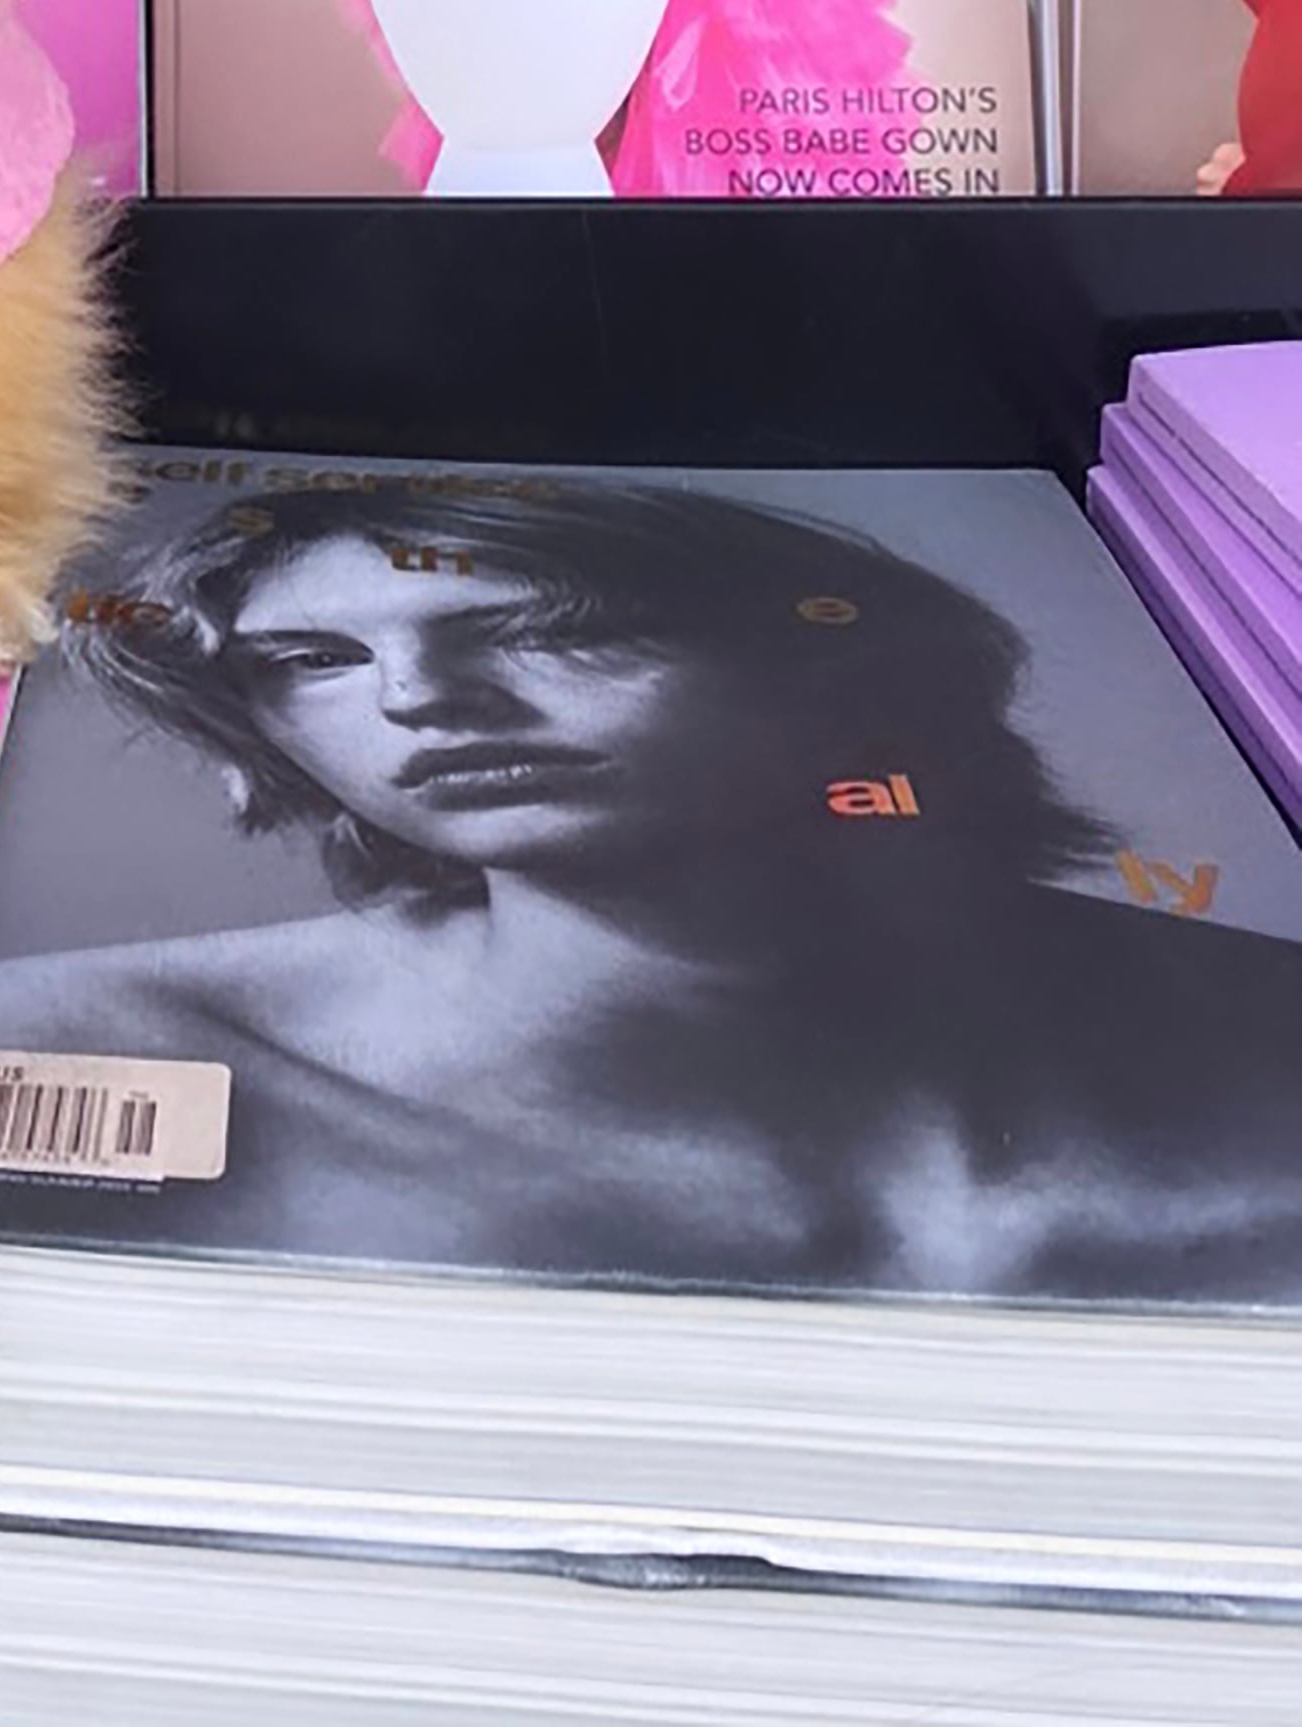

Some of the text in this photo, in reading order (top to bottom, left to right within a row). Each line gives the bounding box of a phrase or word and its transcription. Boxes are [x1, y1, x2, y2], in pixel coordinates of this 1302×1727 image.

[739, 86, 999, 115] PARIS HILTON'S
[684, 127, 999, 156] BOSS BABE GOWN
[728, 168, 1000, 196] NOW COMES IN
[826, 774, 920, 816] al
[1117, 848, 1219, 917] ly
